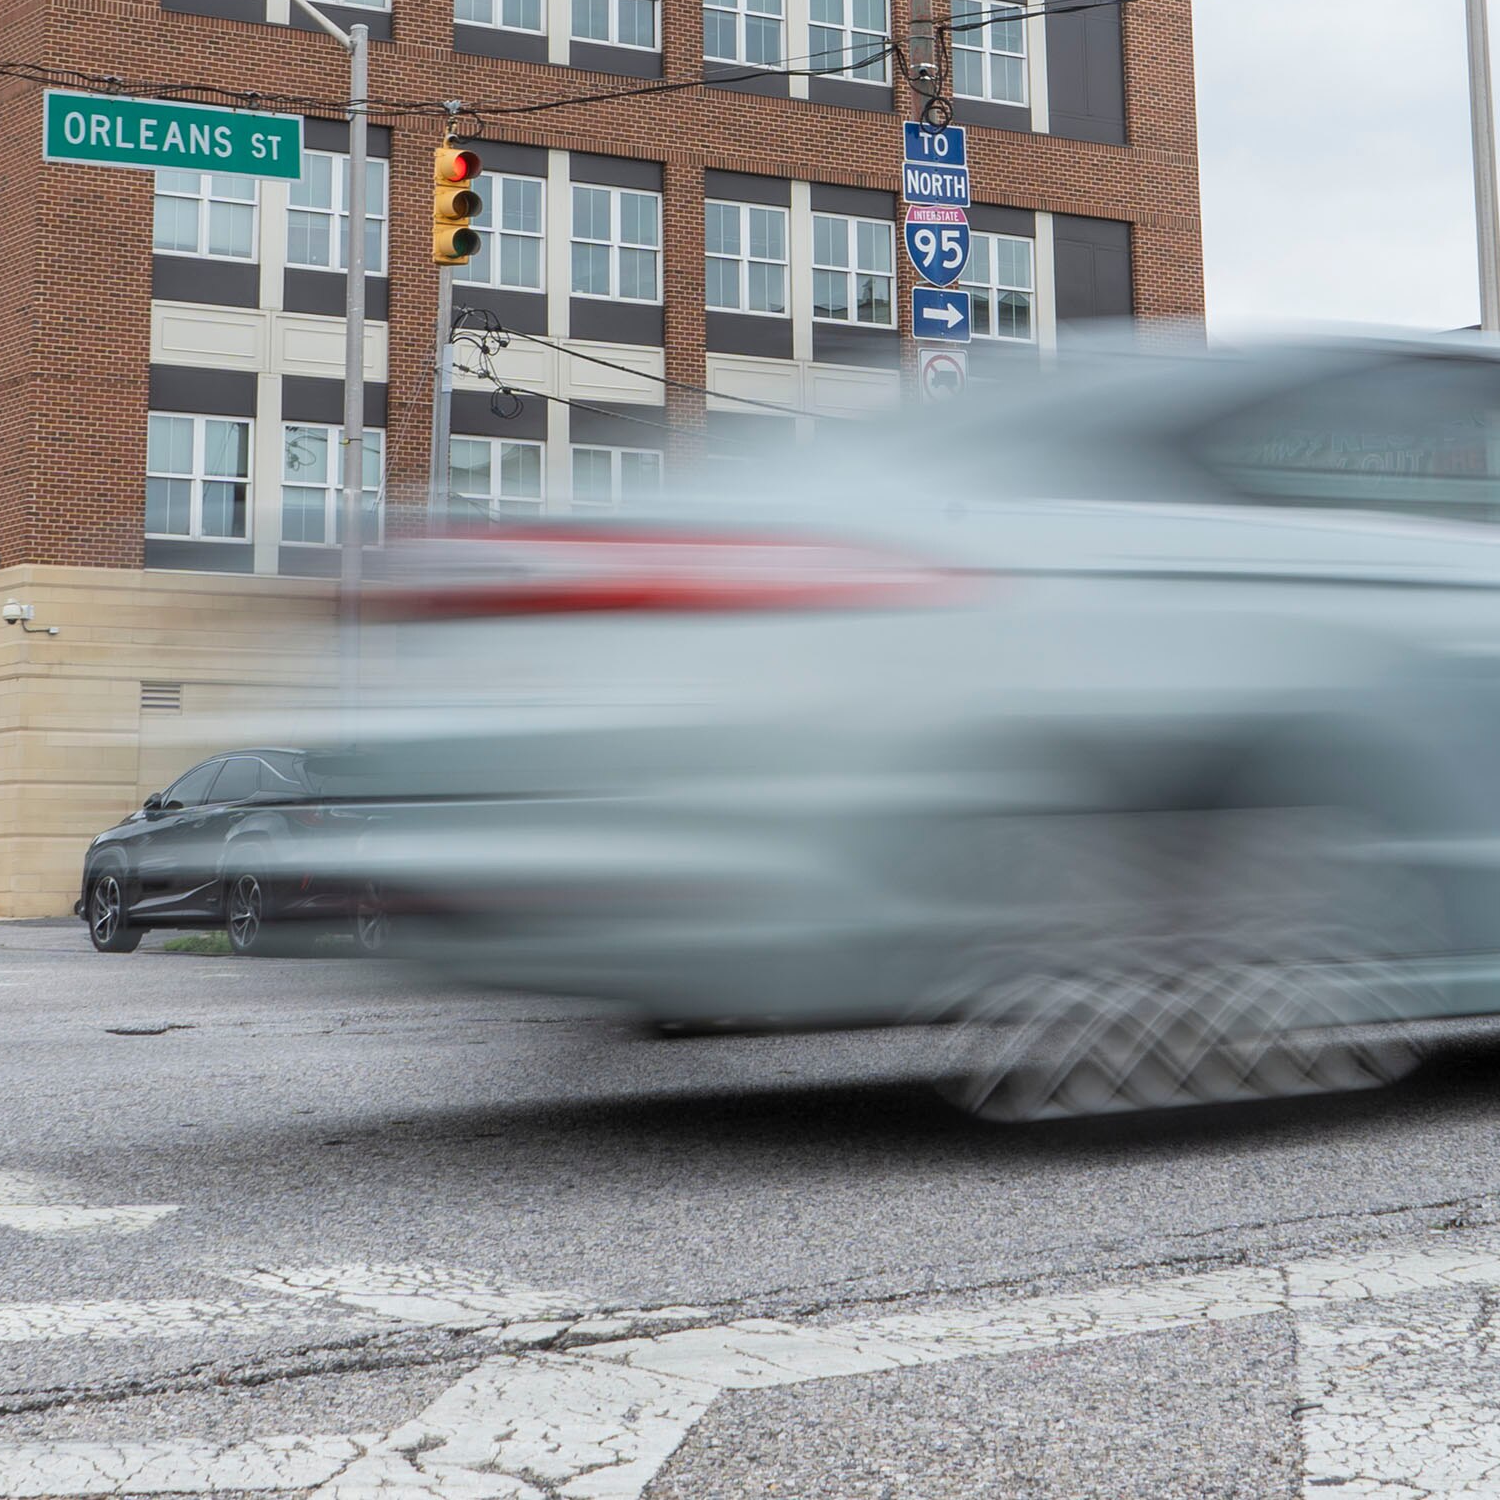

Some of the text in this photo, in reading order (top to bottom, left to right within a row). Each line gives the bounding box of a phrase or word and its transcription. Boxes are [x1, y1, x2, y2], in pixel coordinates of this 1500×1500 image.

[63, 111, 282, 161] ORLEANS ST
[919, 132, 949, 157] TO
[907, 169, 966, 199] NORTH
[913, 210, 960, 223] INTERSTATE
[914, 229, 963, 269] 95
